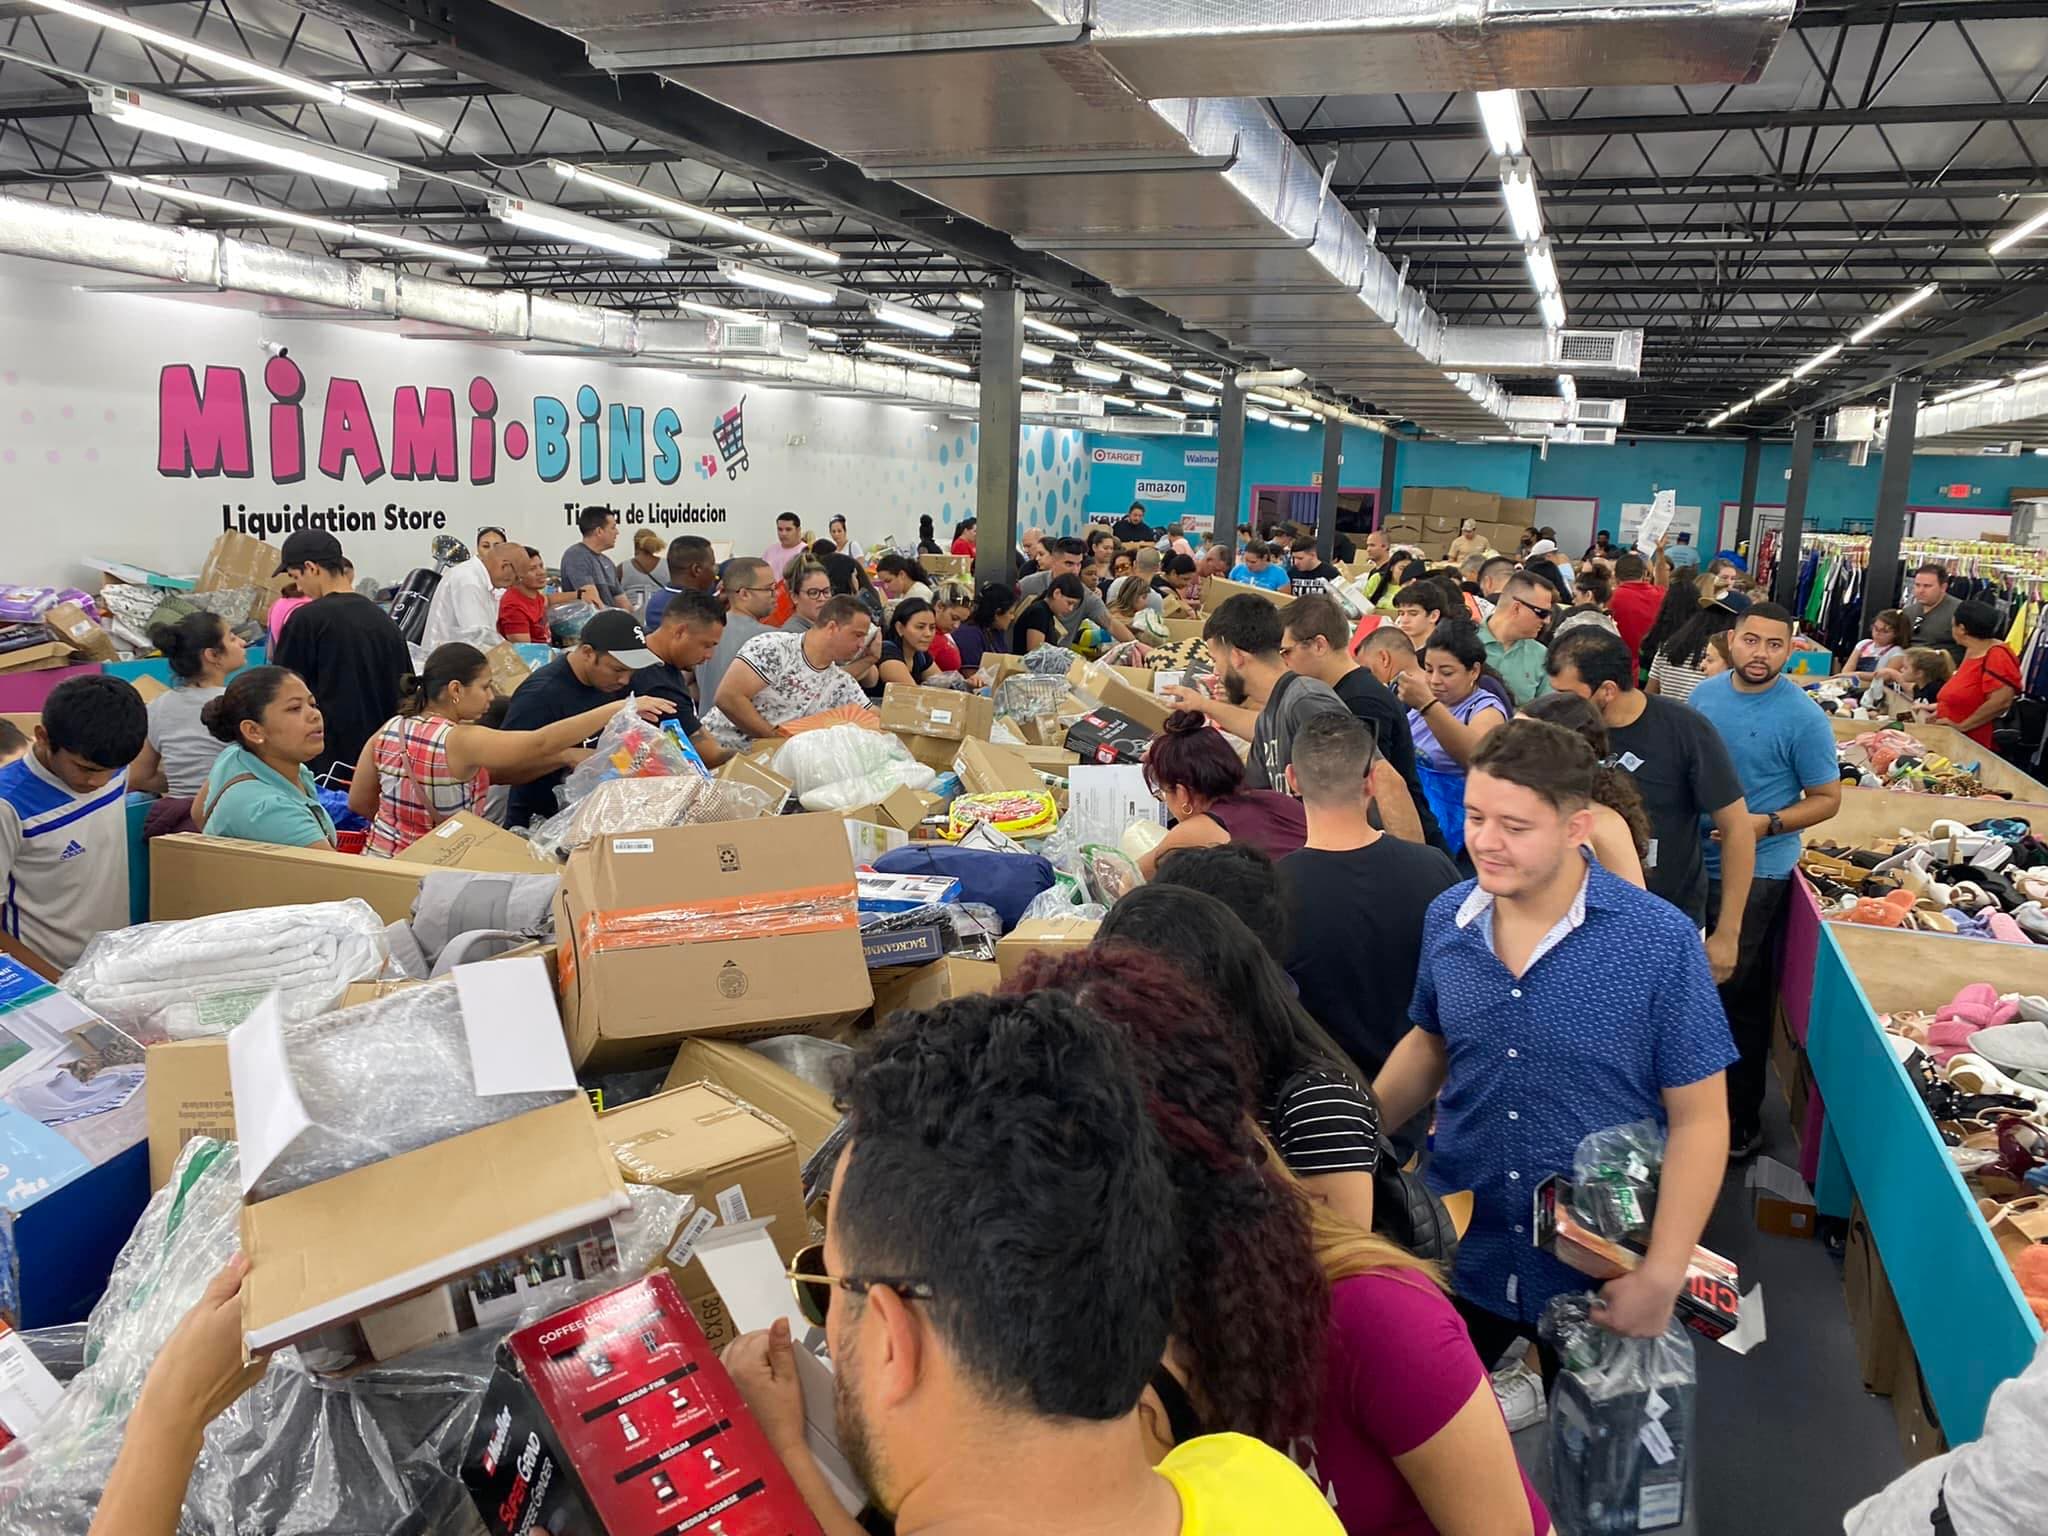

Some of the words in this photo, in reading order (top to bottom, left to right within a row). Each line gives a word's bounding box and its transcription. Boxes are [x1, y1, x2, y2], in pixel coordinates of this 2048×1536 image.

[1106, 452, 1140, 462] TARGET
[1186, 454, 1219, 464] Walmar
[1137, 481, 1185, 493] amazon
[223, 503, 376, 541] Liquidation
[384, 503, 447, 531] Store
[564, 503, 620, 526] Tia
[626, 503, 644, 524] de
[648, 502, 727, 528] Liquidacion
[864, 937, 929, 956] BACKGAMMO
[538, 1319, 585, 1345] COFFEE
[658, 1440, 691, 1461] MEDIUM
